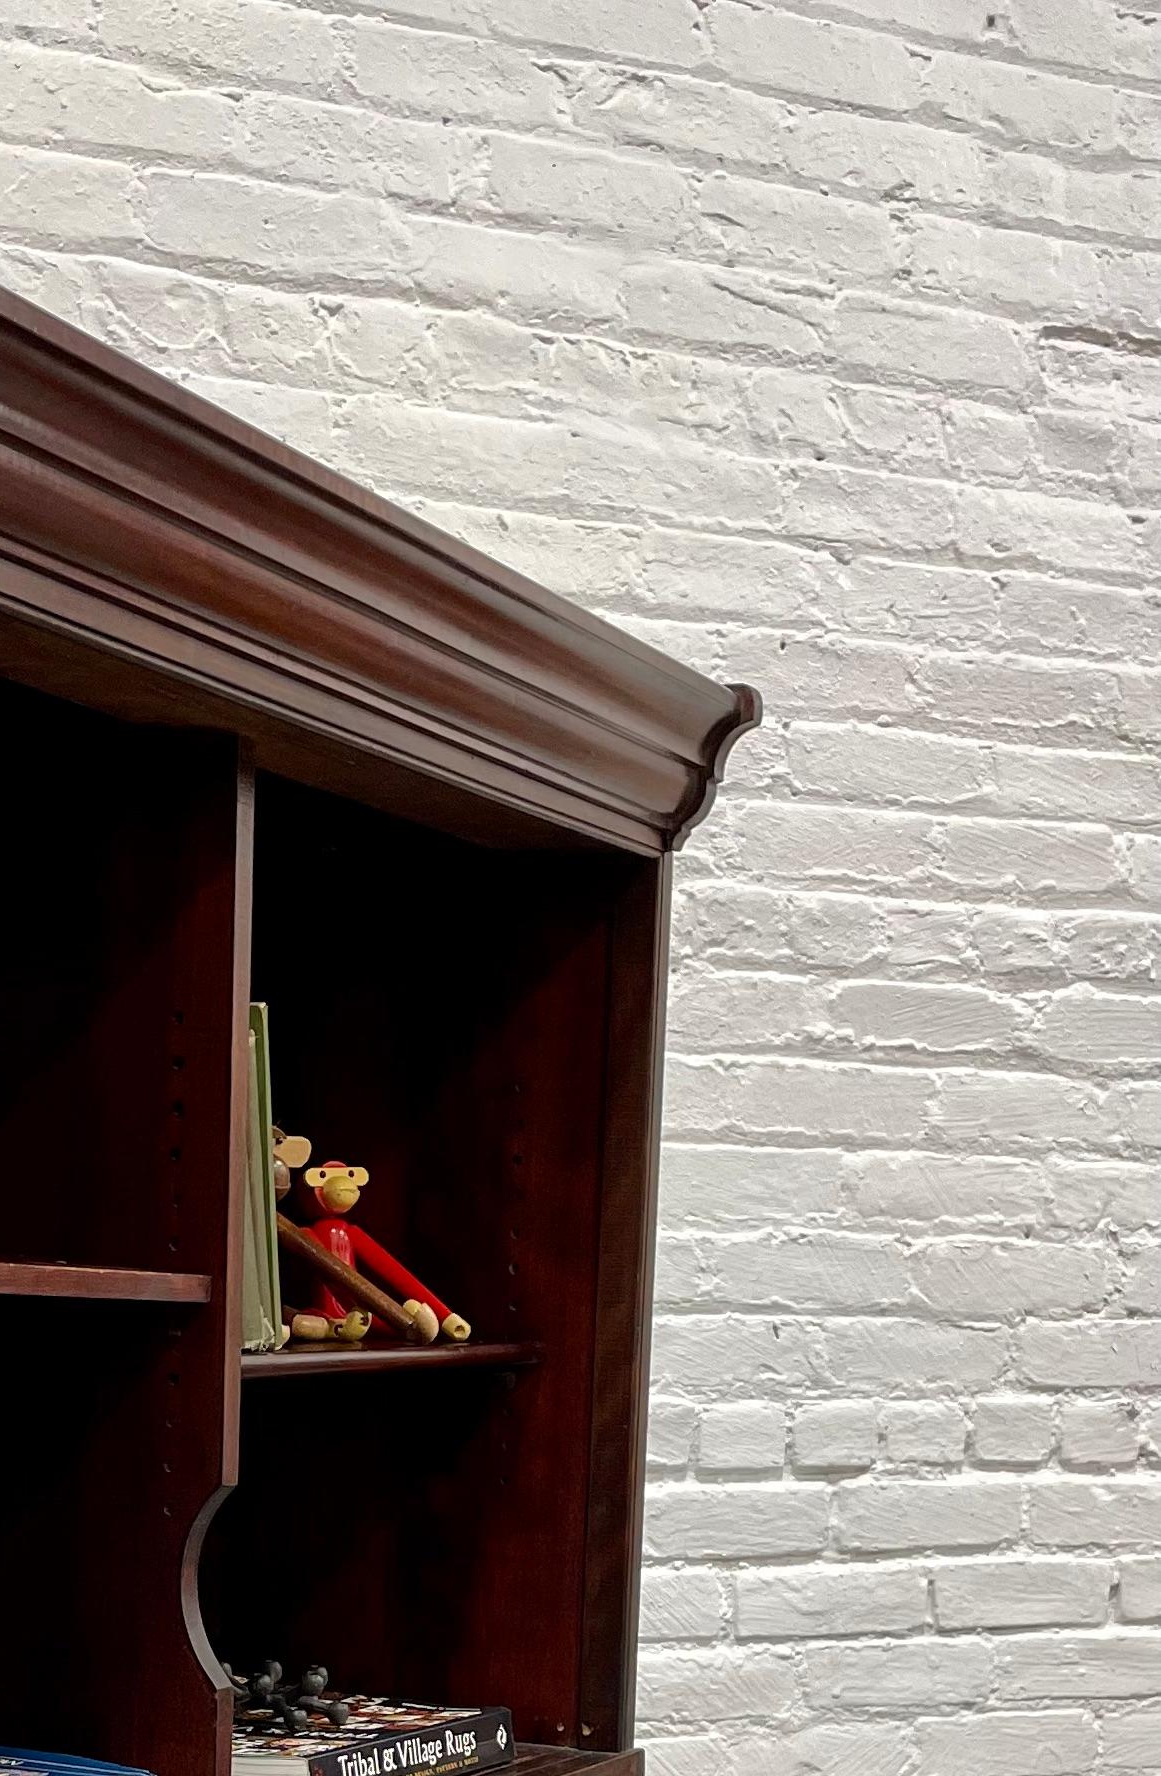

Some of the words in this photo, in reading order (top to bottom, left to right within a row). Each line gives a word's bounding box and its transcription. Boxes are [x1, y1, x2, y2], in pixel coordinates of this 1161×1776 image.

[383, 1751, 398, 1772] &
[396, 1735, 443, 1768] Village
[445, 1729, 477, 1757] Rugs
